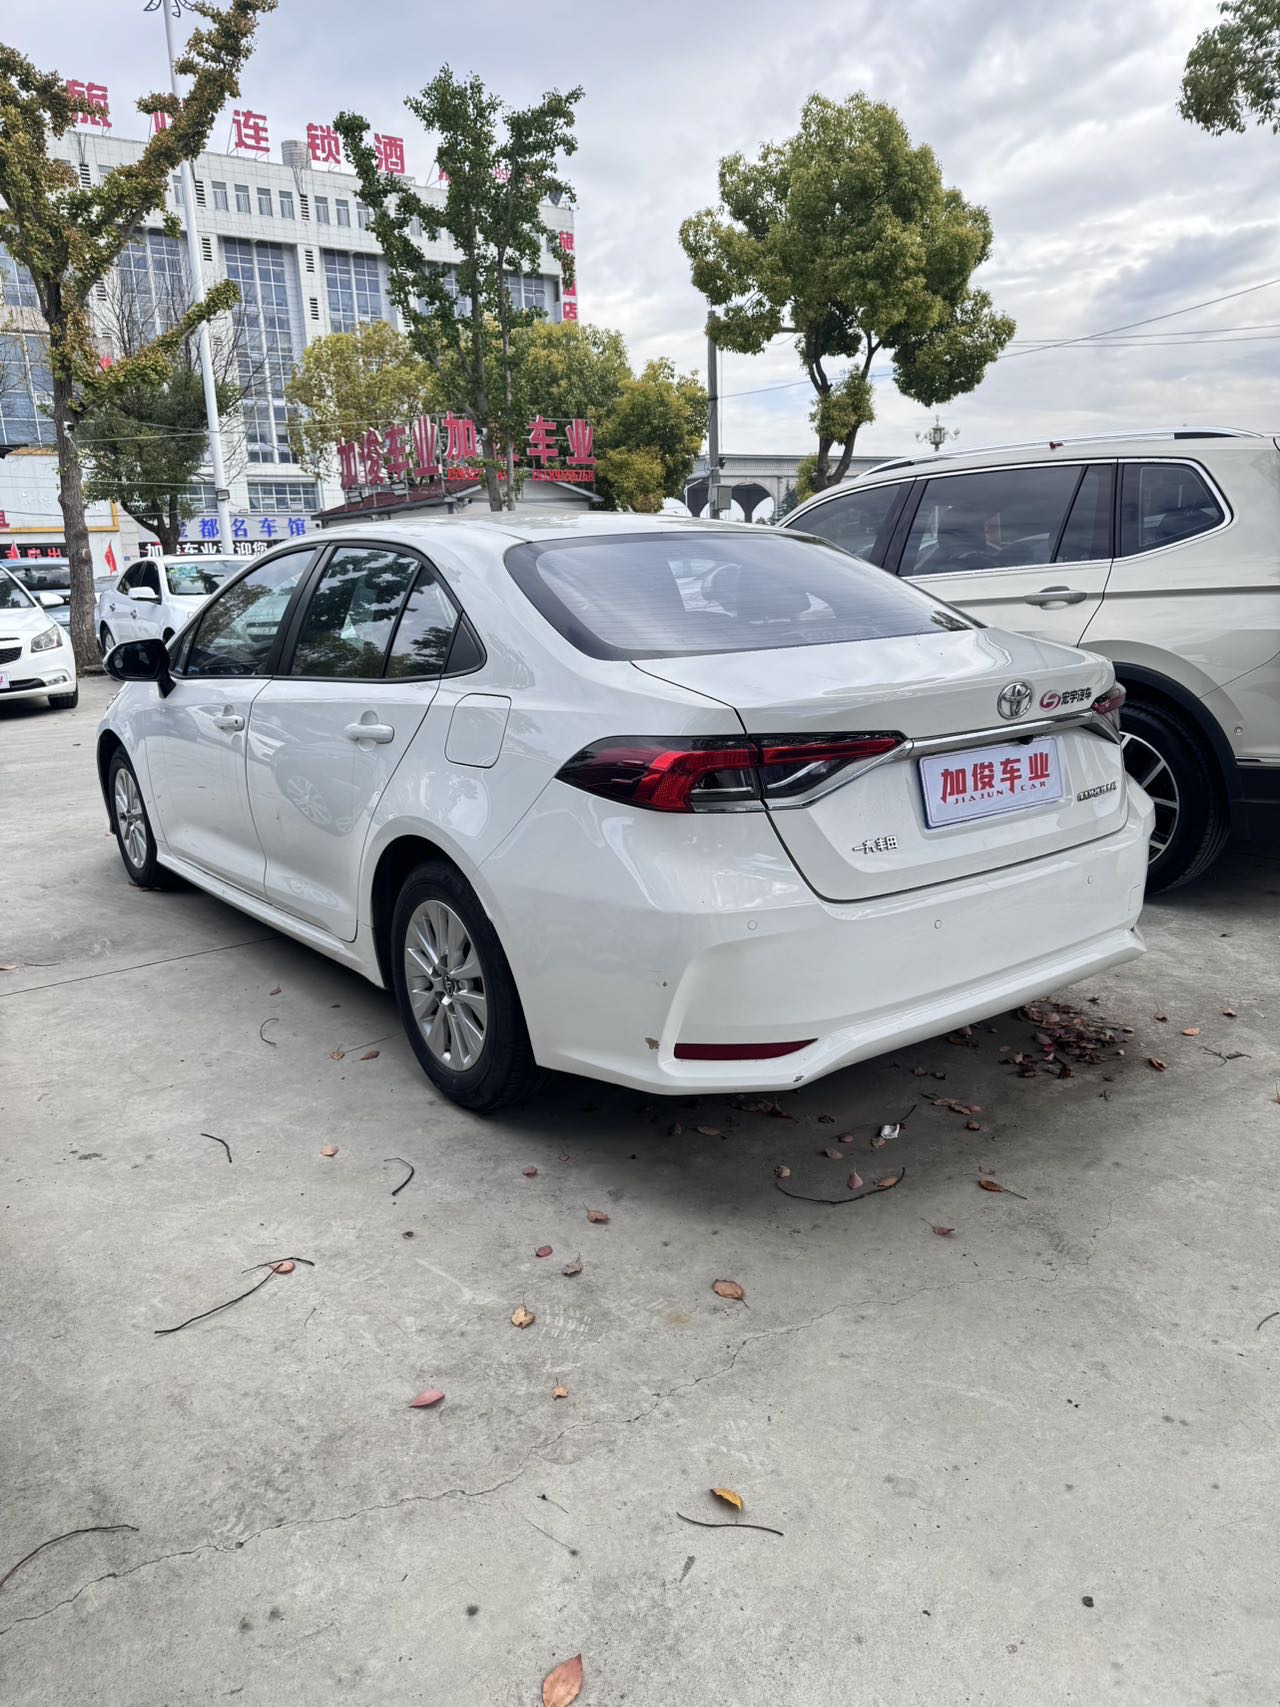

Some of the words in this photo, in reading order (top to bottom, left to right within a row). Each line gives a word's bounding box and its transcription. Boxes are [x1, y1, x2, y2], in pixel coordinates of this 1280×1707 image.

[337, 415, 442, 490] 加俊车业
[442, 411, 596, 464] 加车业
[1061, 687, 1092, 705] 宏宇汽车
[940, 752, 1050, 804] 加俊车业
[953, 789, 1004, 805] JIAJUN
[1020, 781, 1047, 792] CAR
[852, 835, 898, 854] 一汽丰田
